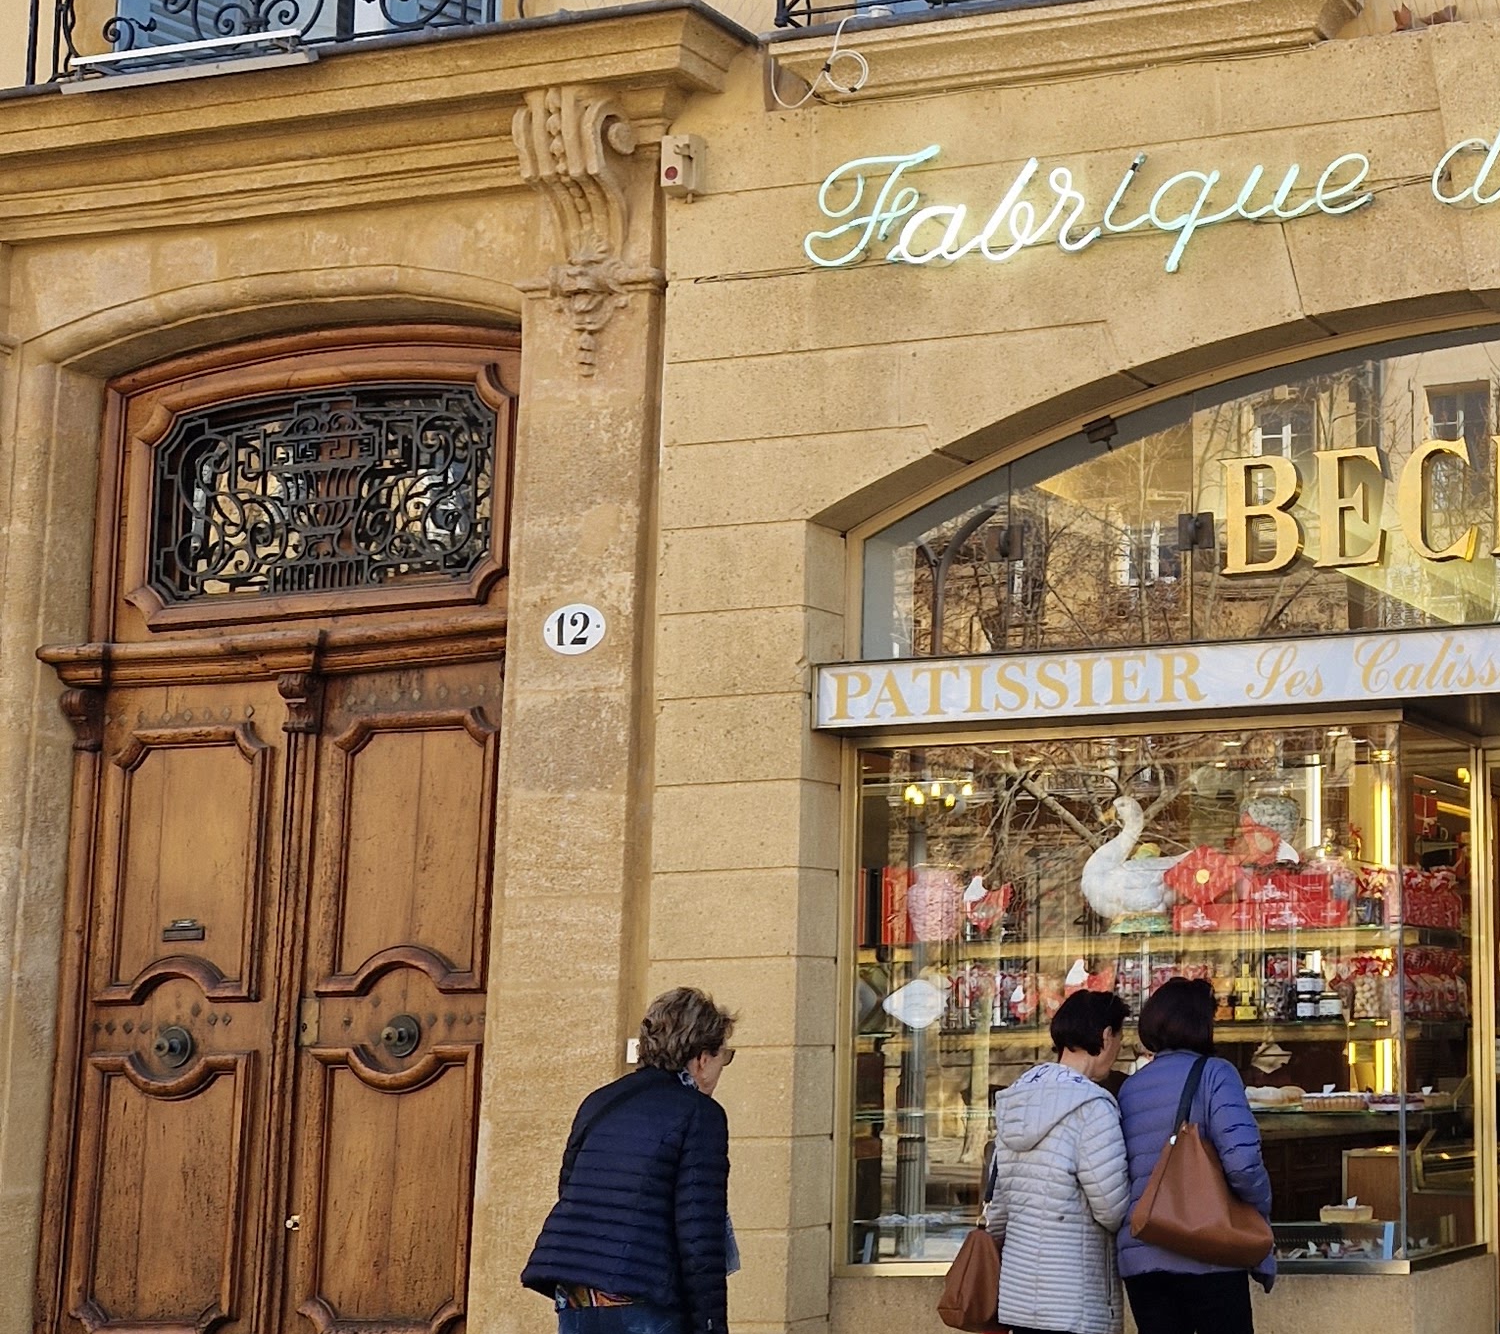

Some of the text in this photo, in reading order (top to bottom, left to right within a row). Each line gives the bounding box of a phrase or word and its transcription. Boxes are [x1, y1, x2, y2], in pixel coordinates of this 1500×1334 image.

[804, 144, 1375, 273] Fabrique
[555, 611, 590, 646] 12
[828, 650, 1207, 721] PATISSIER
